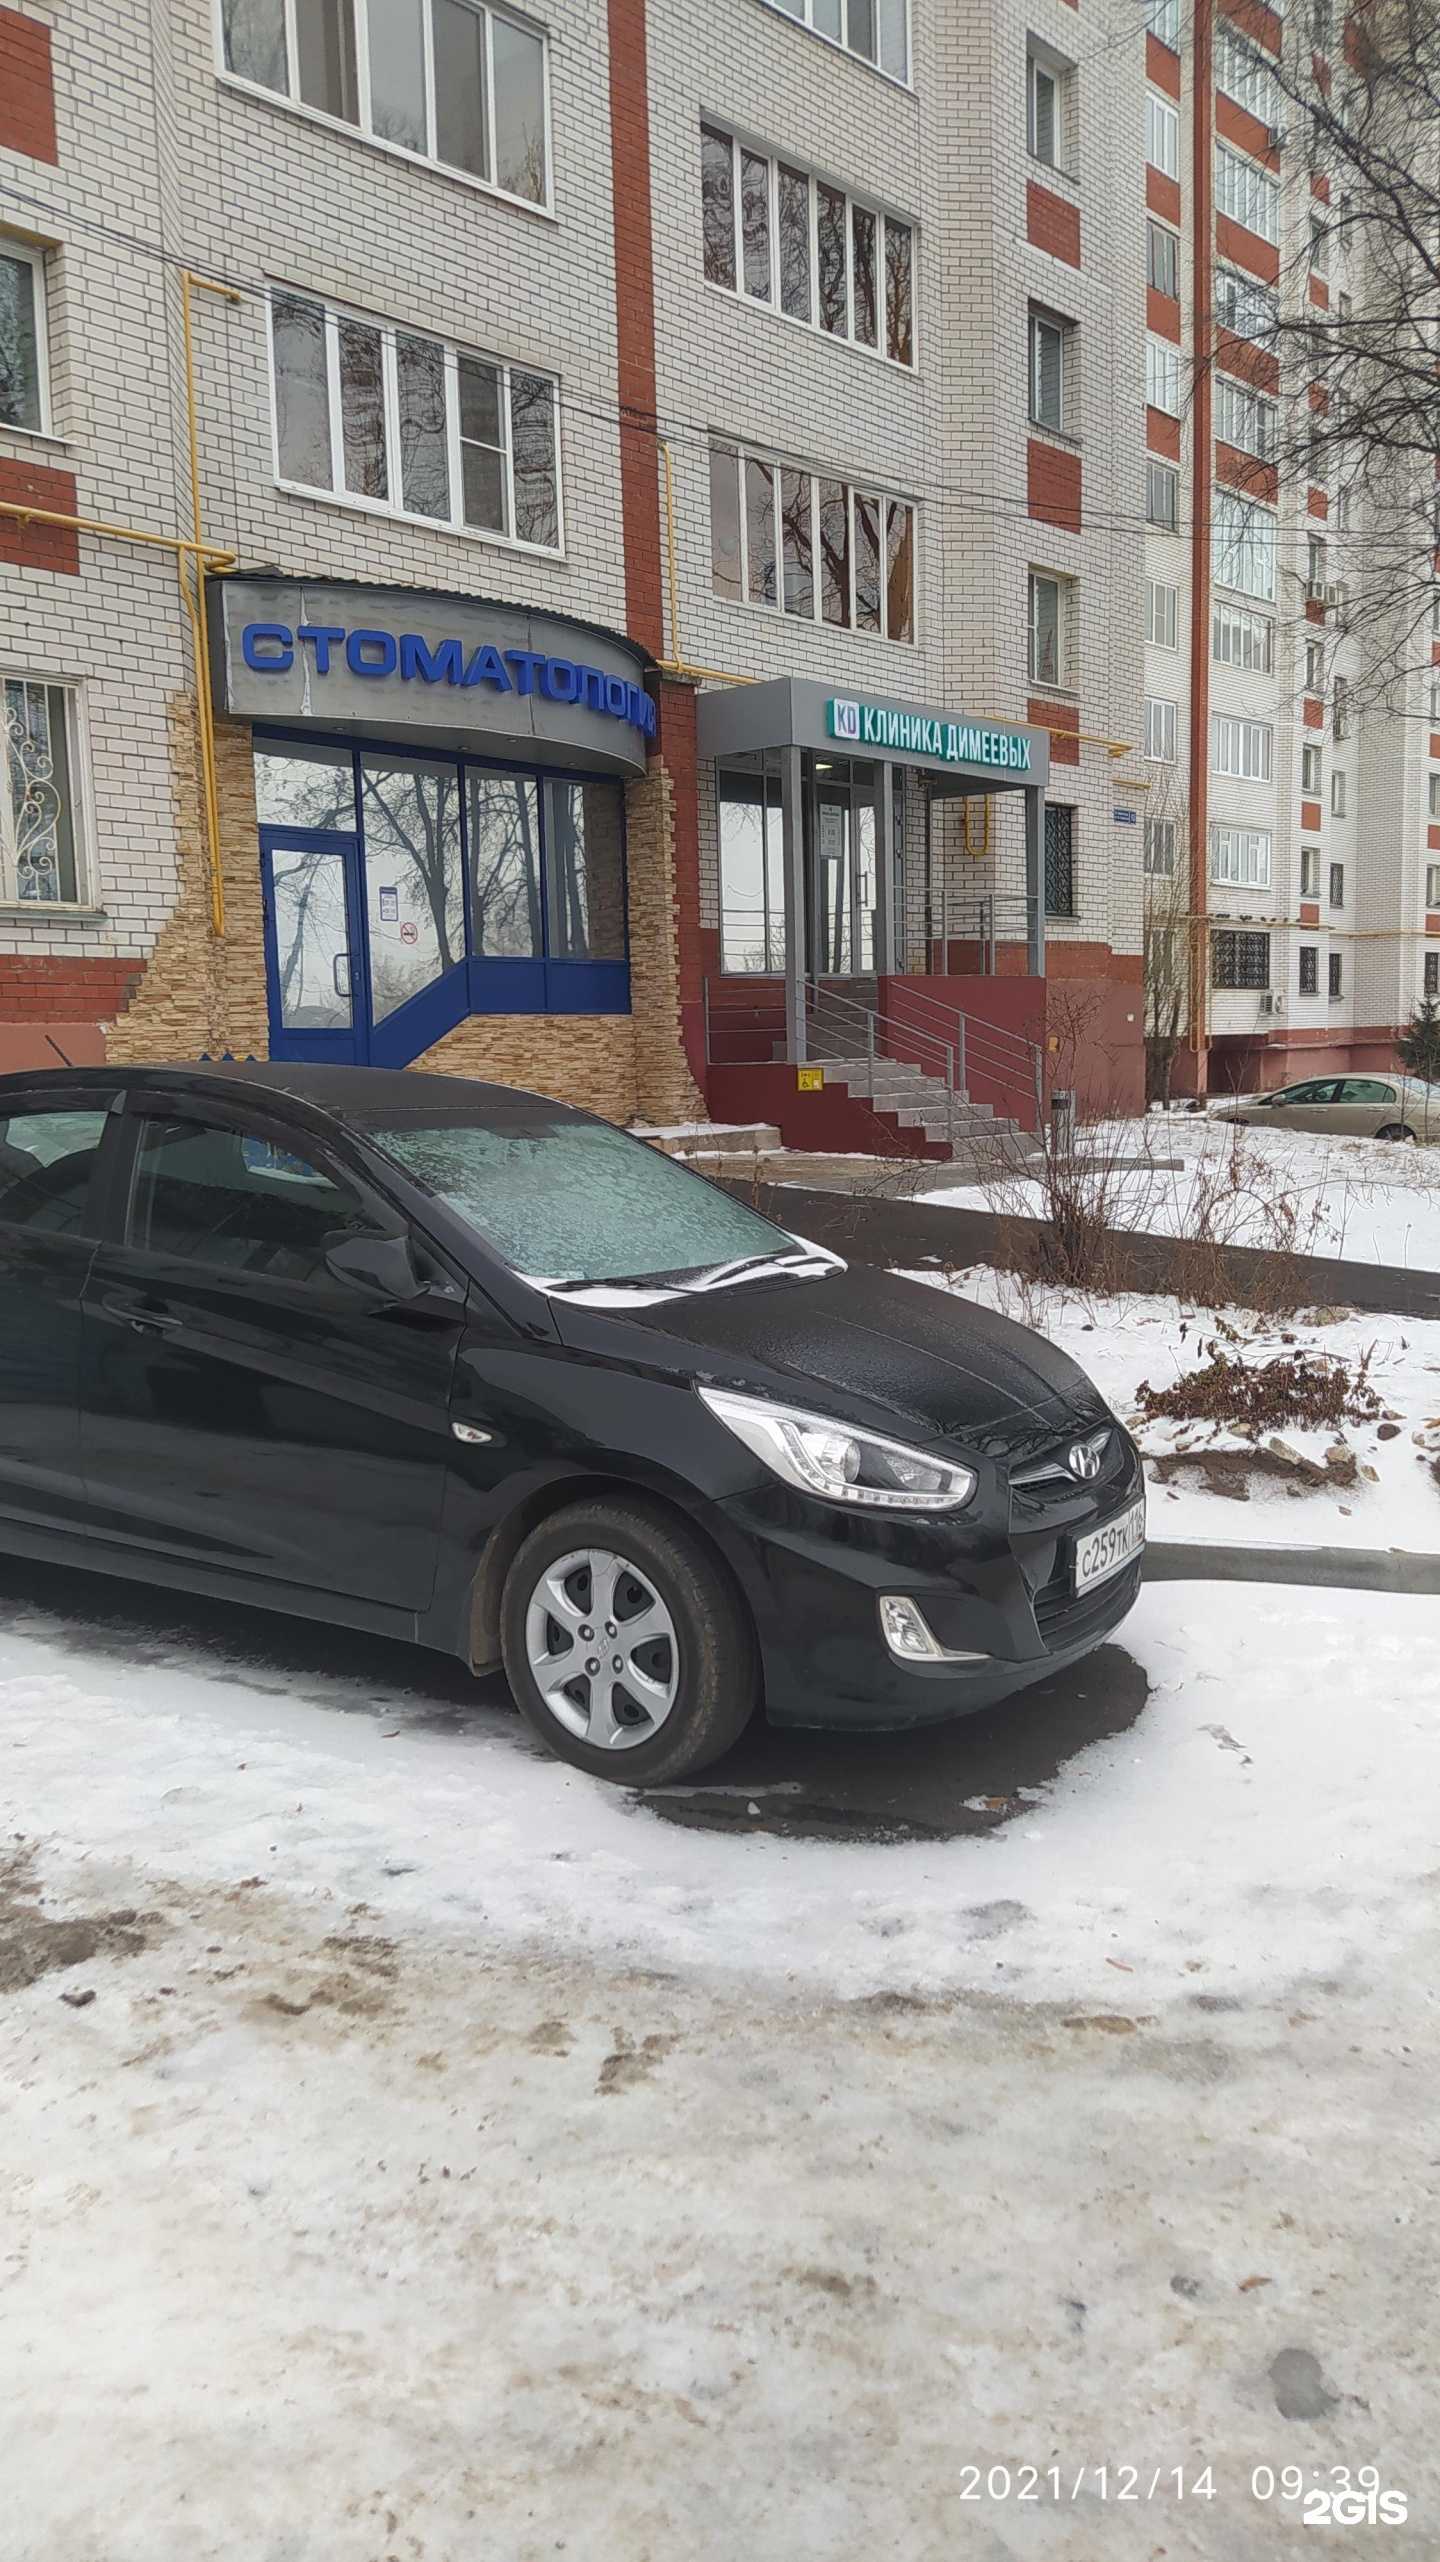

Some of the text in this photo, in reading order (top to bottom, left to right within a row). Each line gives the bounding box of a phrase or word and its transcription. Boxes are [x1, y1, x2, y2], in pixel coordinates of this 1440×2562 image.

[837, 704, 857, 735] KD
[864, 706, 1032, 769] КЛИНИКА ДИМЕЕВЫХ
